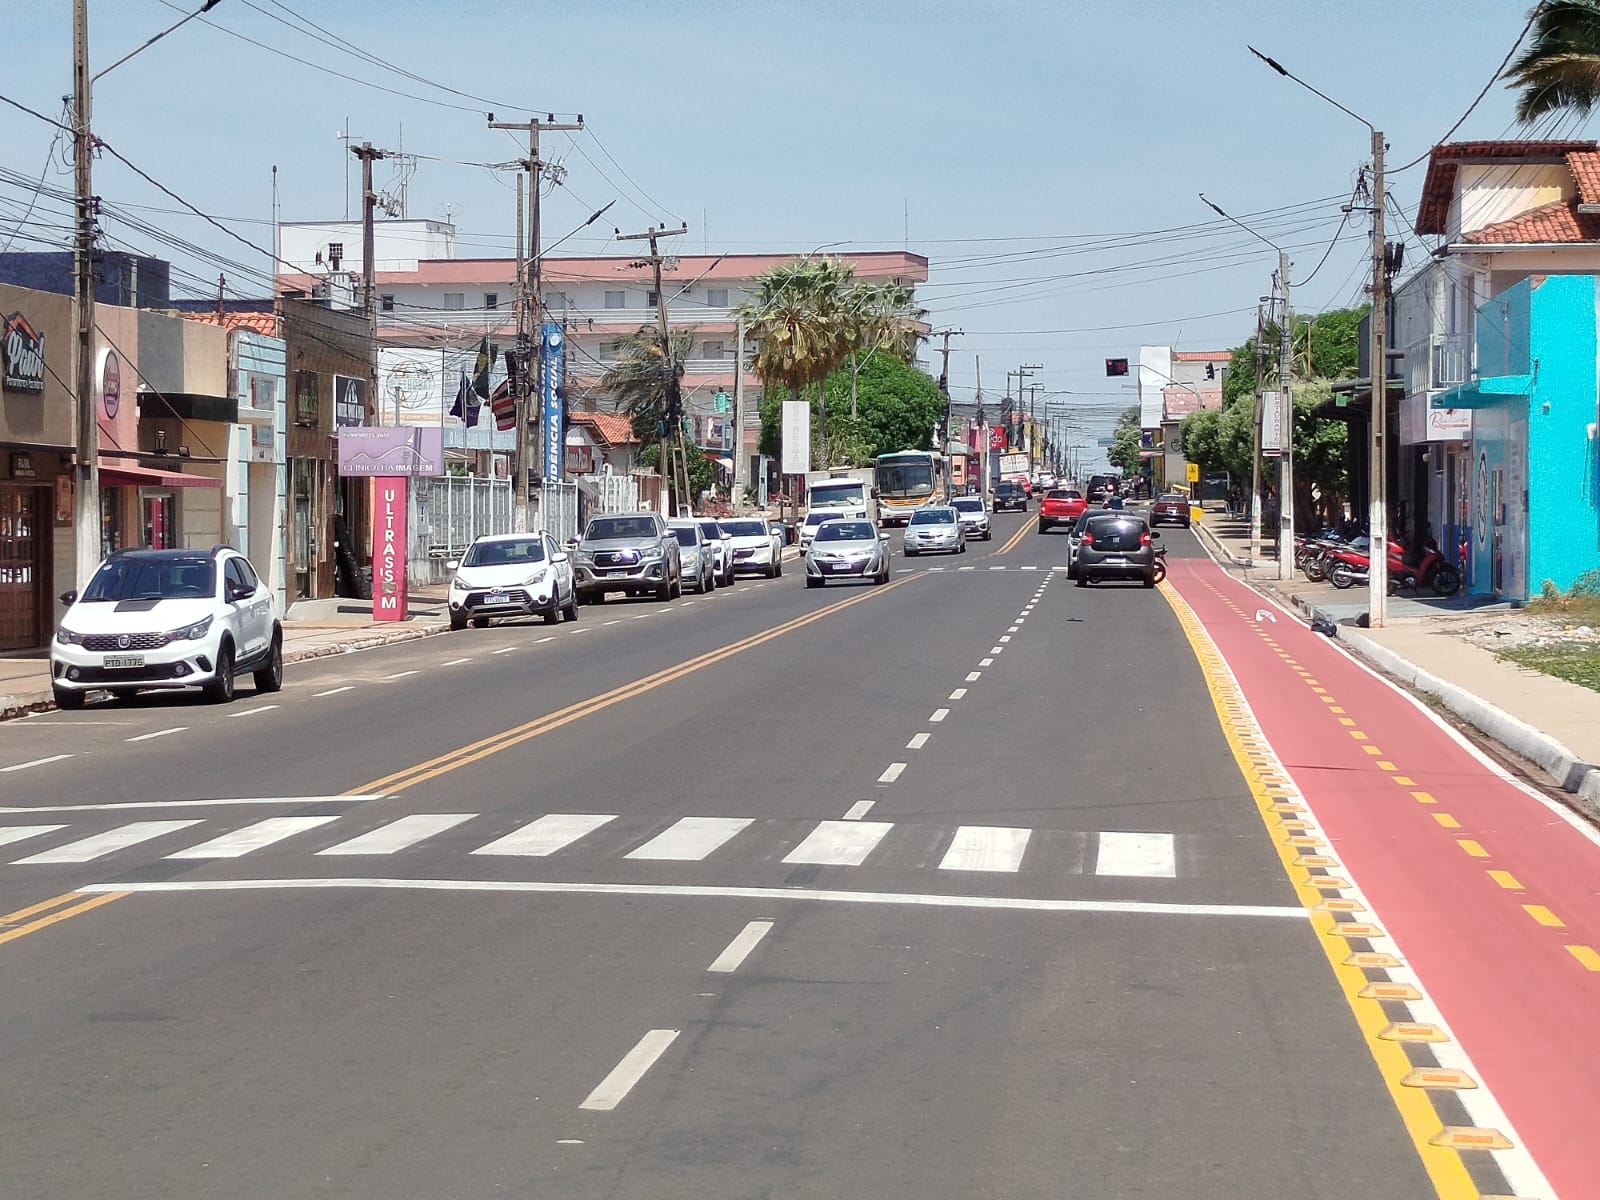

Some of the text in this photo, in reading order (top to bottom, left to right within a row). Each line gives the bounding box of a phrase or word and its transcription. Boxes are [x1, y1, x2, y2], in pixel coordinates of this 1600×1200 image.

[550, 357, 559, 409] SOCIAL
[395, 464, 433, 472] IMAGEM
[381, 489, 397, 609] ULTRASSM
